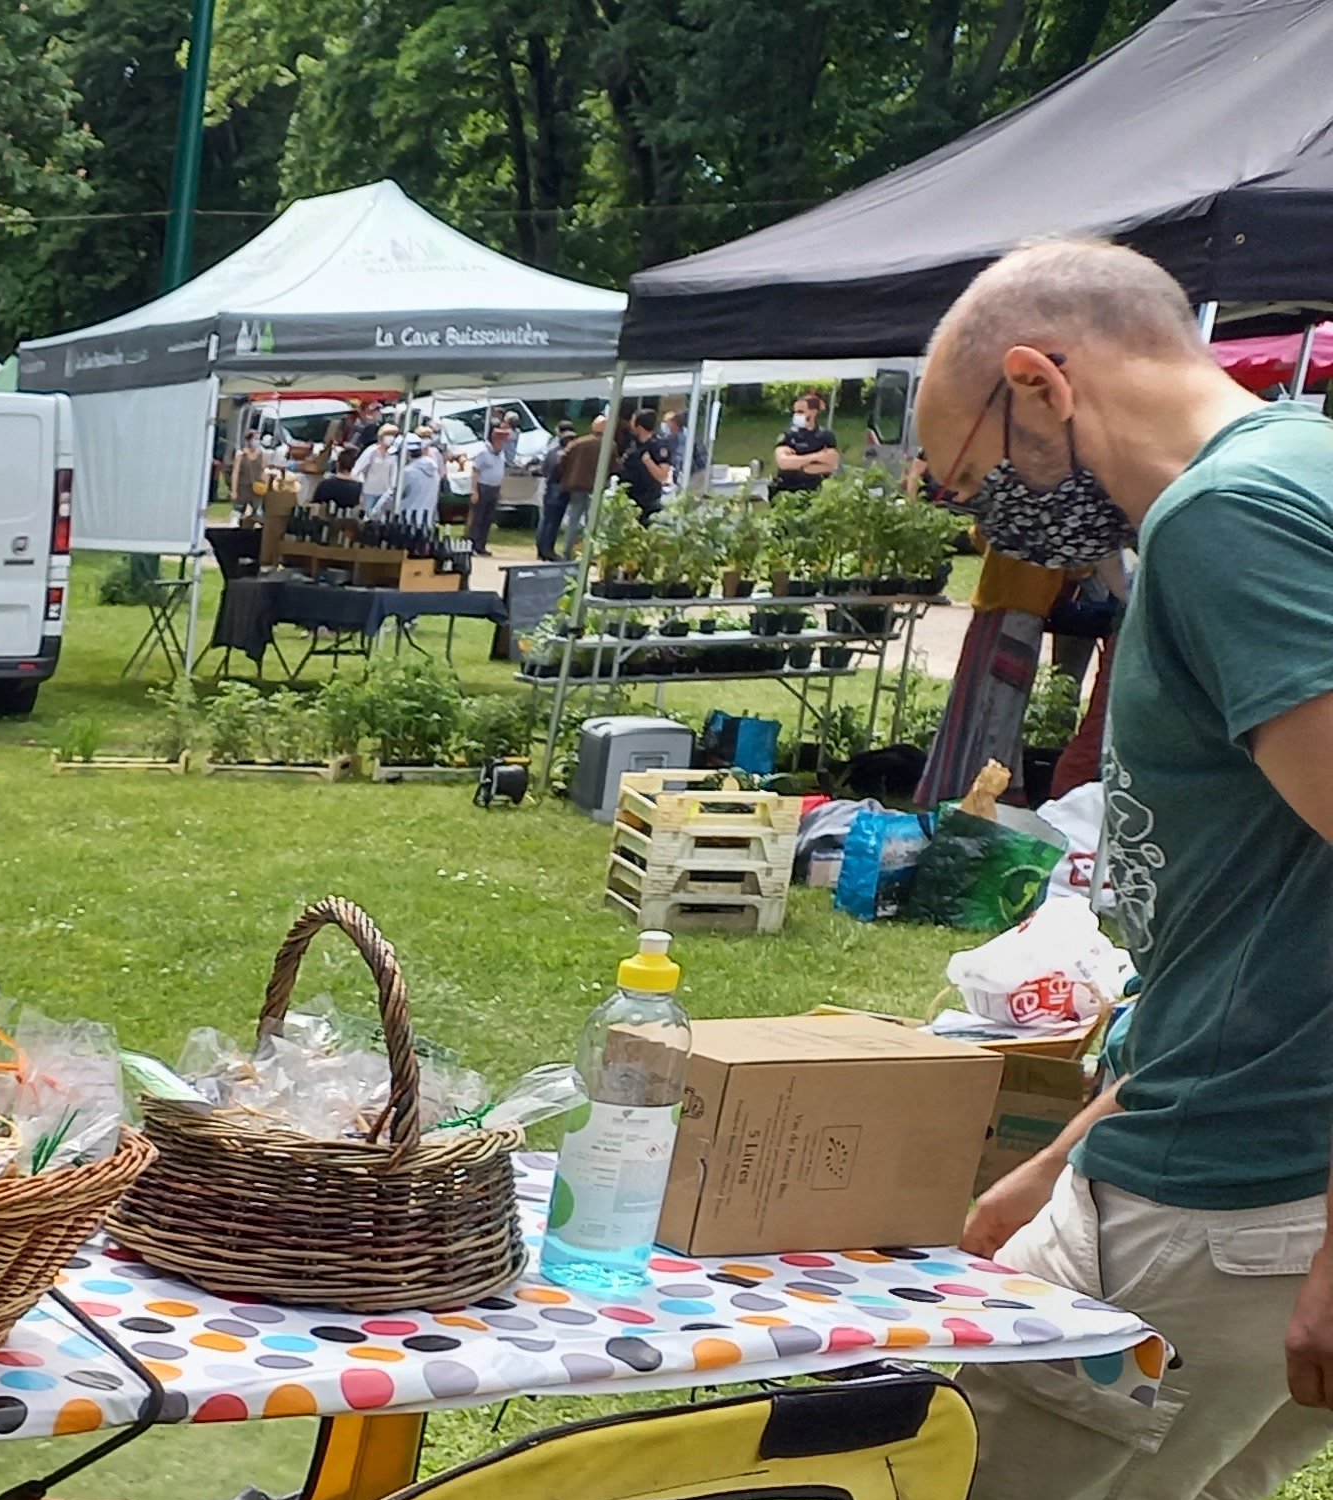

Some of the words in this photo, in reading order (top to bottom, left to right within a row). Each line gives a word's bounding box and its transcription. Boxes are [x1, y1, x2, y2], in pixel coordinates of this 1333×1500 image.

[375, 326, 395, 347] La
[400, 326, 441, 347] Cave
[445, 321, 550, 347] Buissonnière
[738, 1143, 759, 1185] Litres
